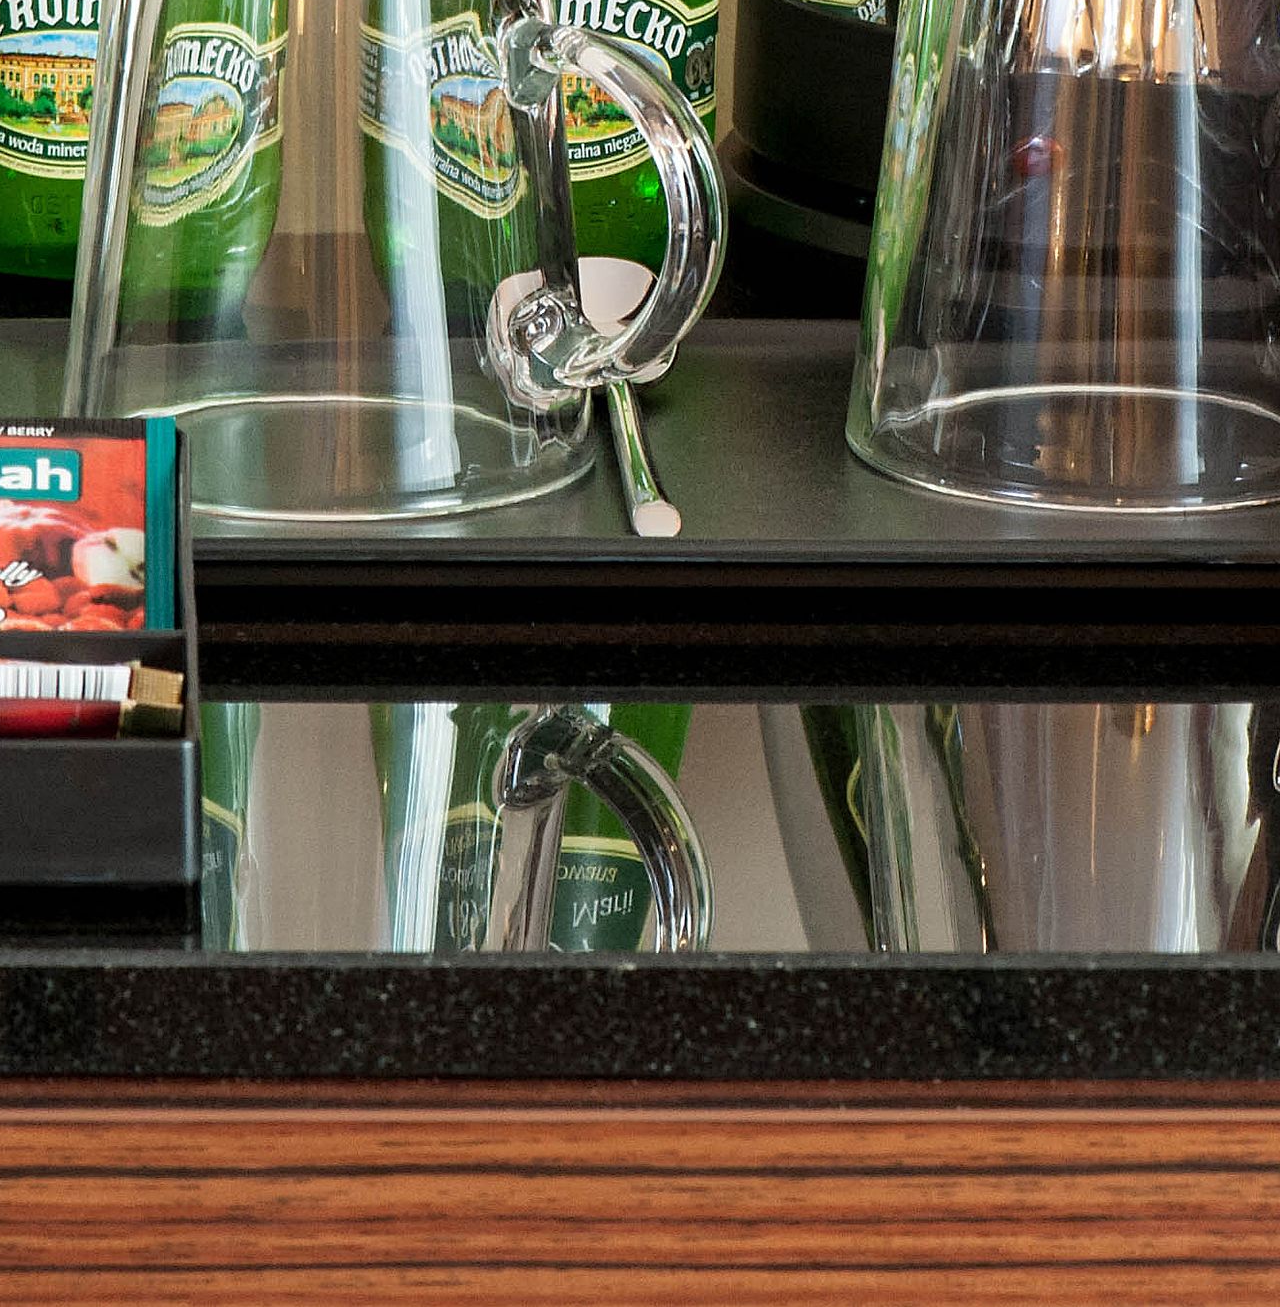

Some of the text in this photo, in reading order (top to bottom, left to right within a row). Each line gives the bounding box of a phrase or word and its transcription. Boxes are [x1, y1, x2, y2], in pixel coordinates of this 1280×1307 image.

[8, 135, 44, 154] woda
[47, 143, 87, 158] miner
[569, 133, 645, 160] ralna niegaz
[7, 426, 55, 438] BERRY
